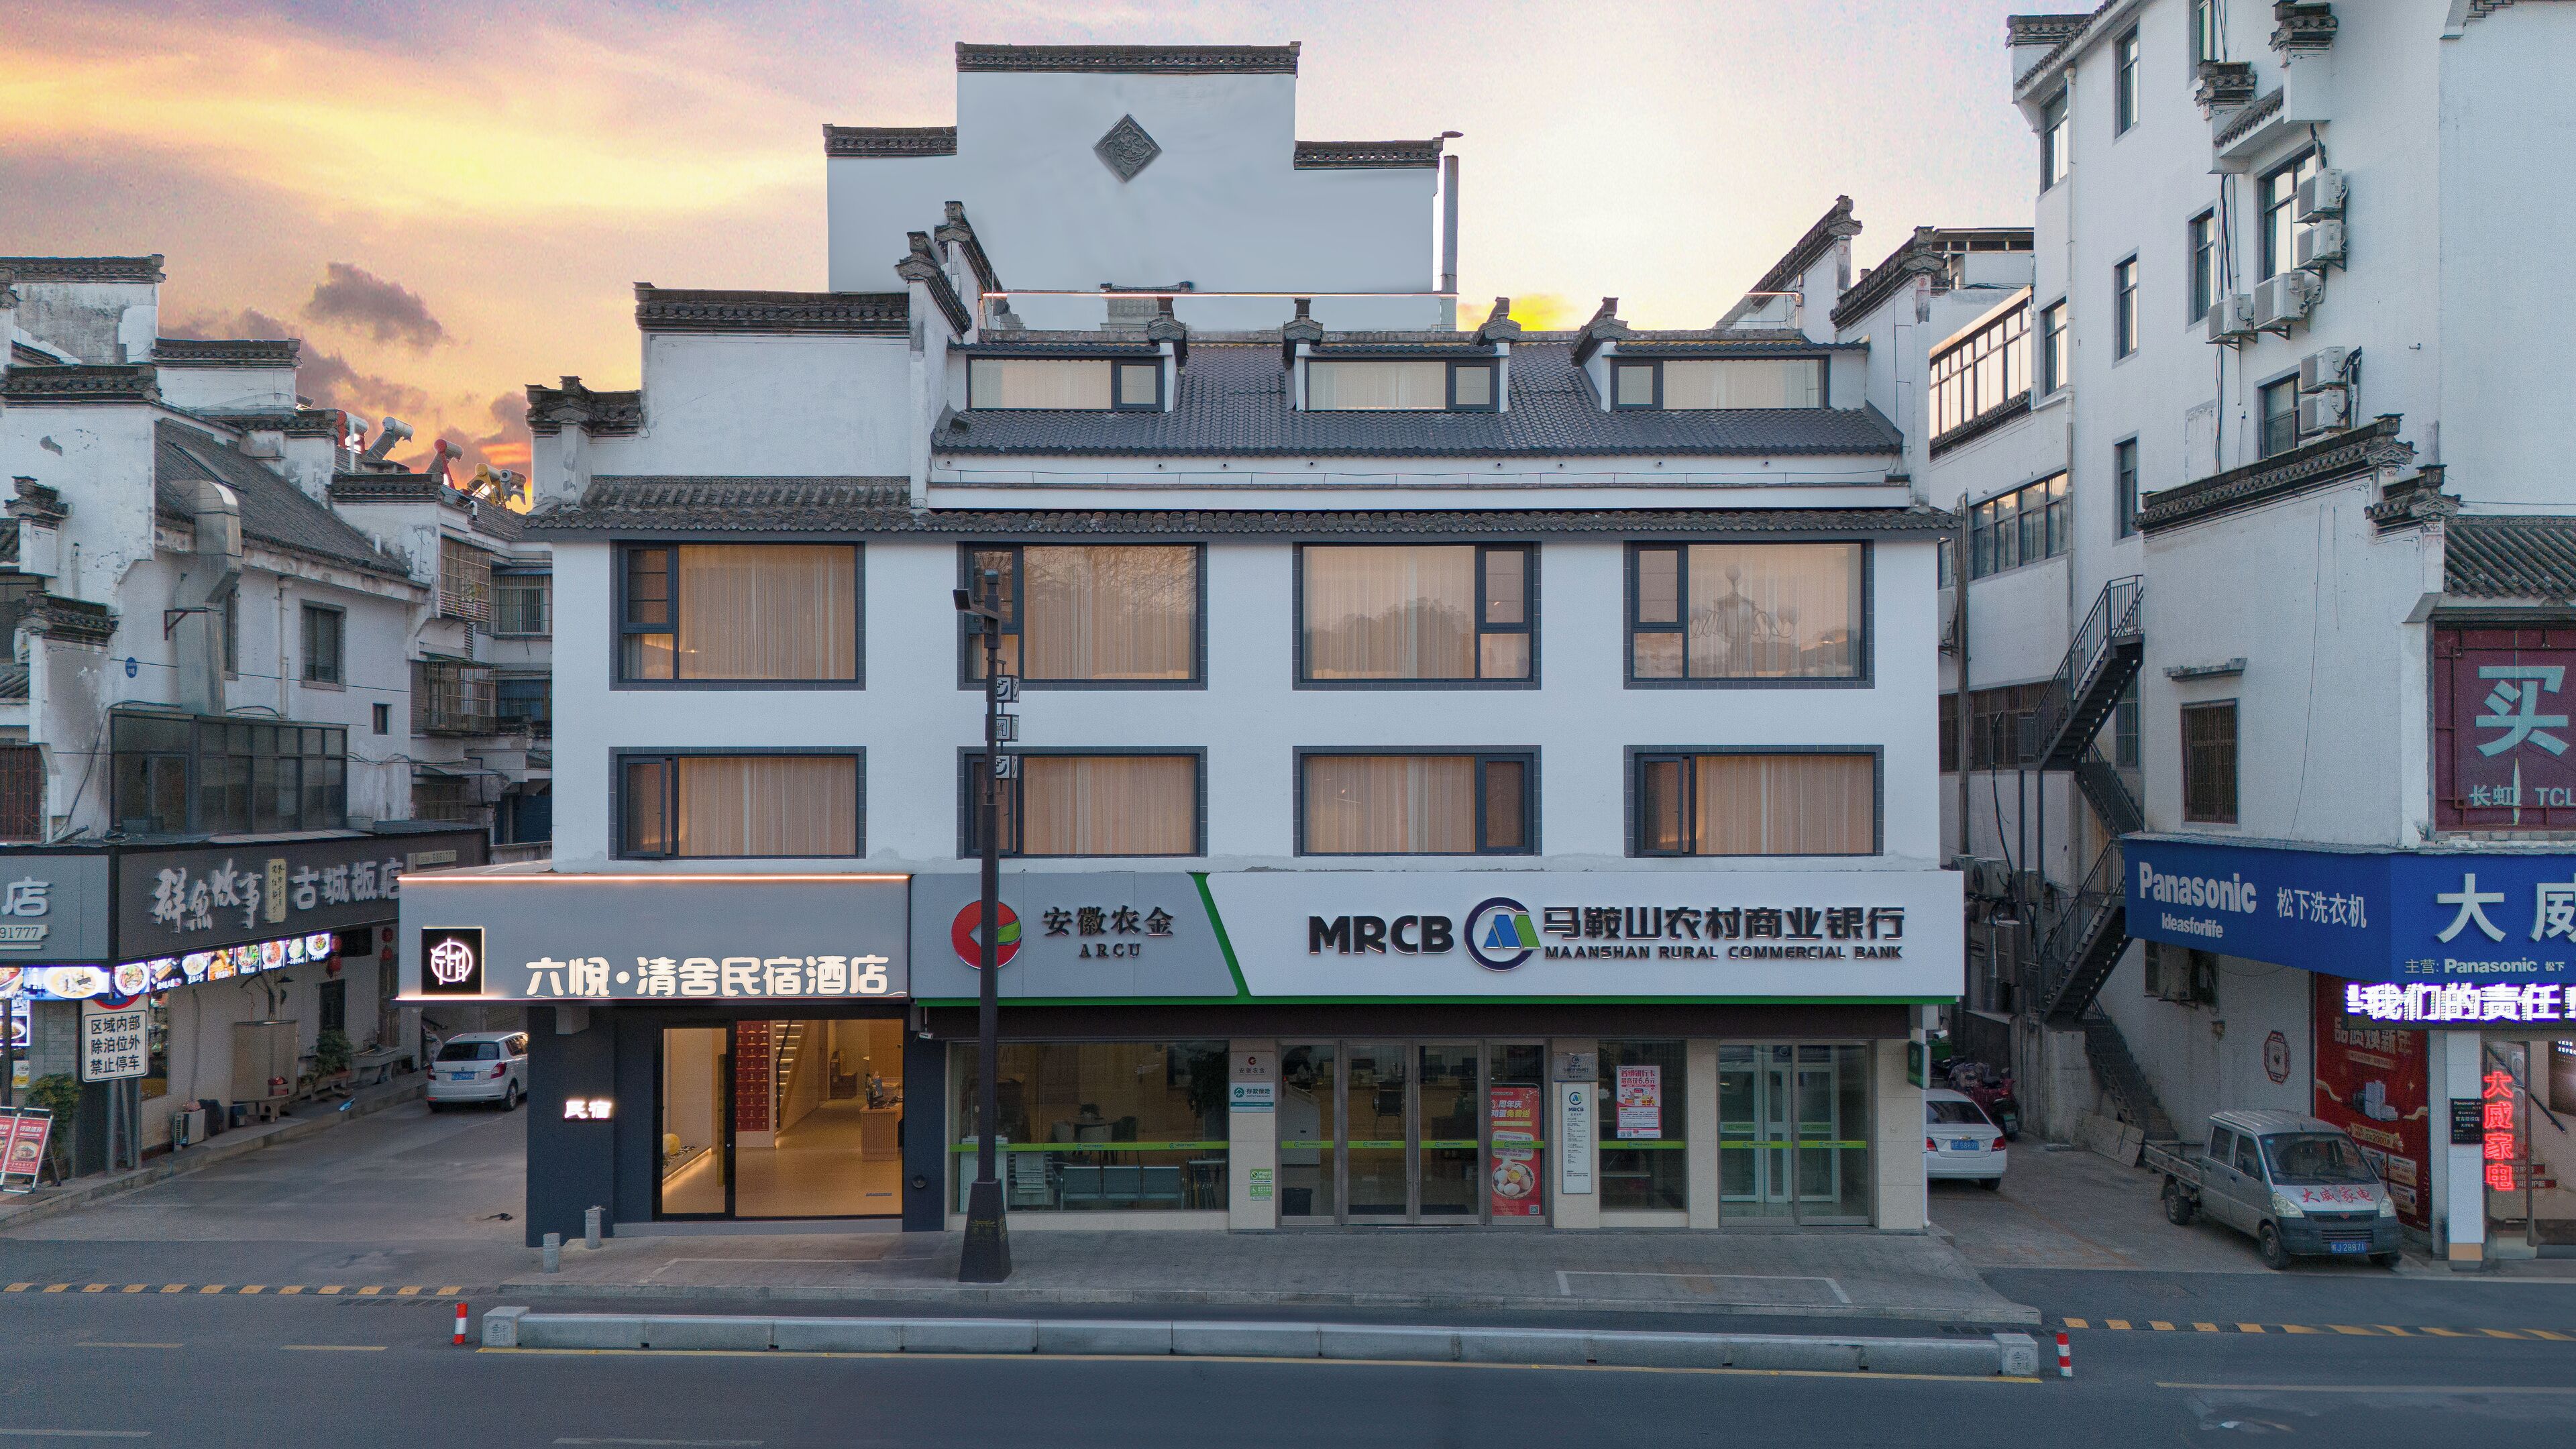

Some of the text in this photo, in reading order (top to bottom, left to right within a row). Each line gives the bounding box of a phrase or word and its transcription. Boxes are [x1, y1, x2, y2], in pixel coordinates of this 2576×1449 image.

[2476, 666, 2569, 757] 买
[2535, 788, 2576, 806] TCL
[1, 876, 49, 916] 店
[291, 857, 403, 909] 古城饭店
[2139, 862, 2366, 928] Panasonic 松下洗衣机
[1042, 906, 1174, 936] 安徽农金
[1543, 906, 1904, 940] 马鞍山农村商业银行
[2436, 873, 2576, 943] 大威
[1309, 915, 1454, 955] MRCB
[1079, 943, 1141, 958] ARCU
[1544, 945, 1903, 959] MAANSHAN RURAL COMMERCIAL BANK
[2444, 957, 2538, 973] Panasonic
[2544, 961, 2565, 972] 松下
[91, 1015, 140, 1034] 区域内部
[91, 1034, 140, 1055] 除泊位外
[90, 1055, 140, 1075] 禁止停车
[564, 1099, 612, 1118] 民宿
[2483, 1070, 2515, 1192] 大威家电
